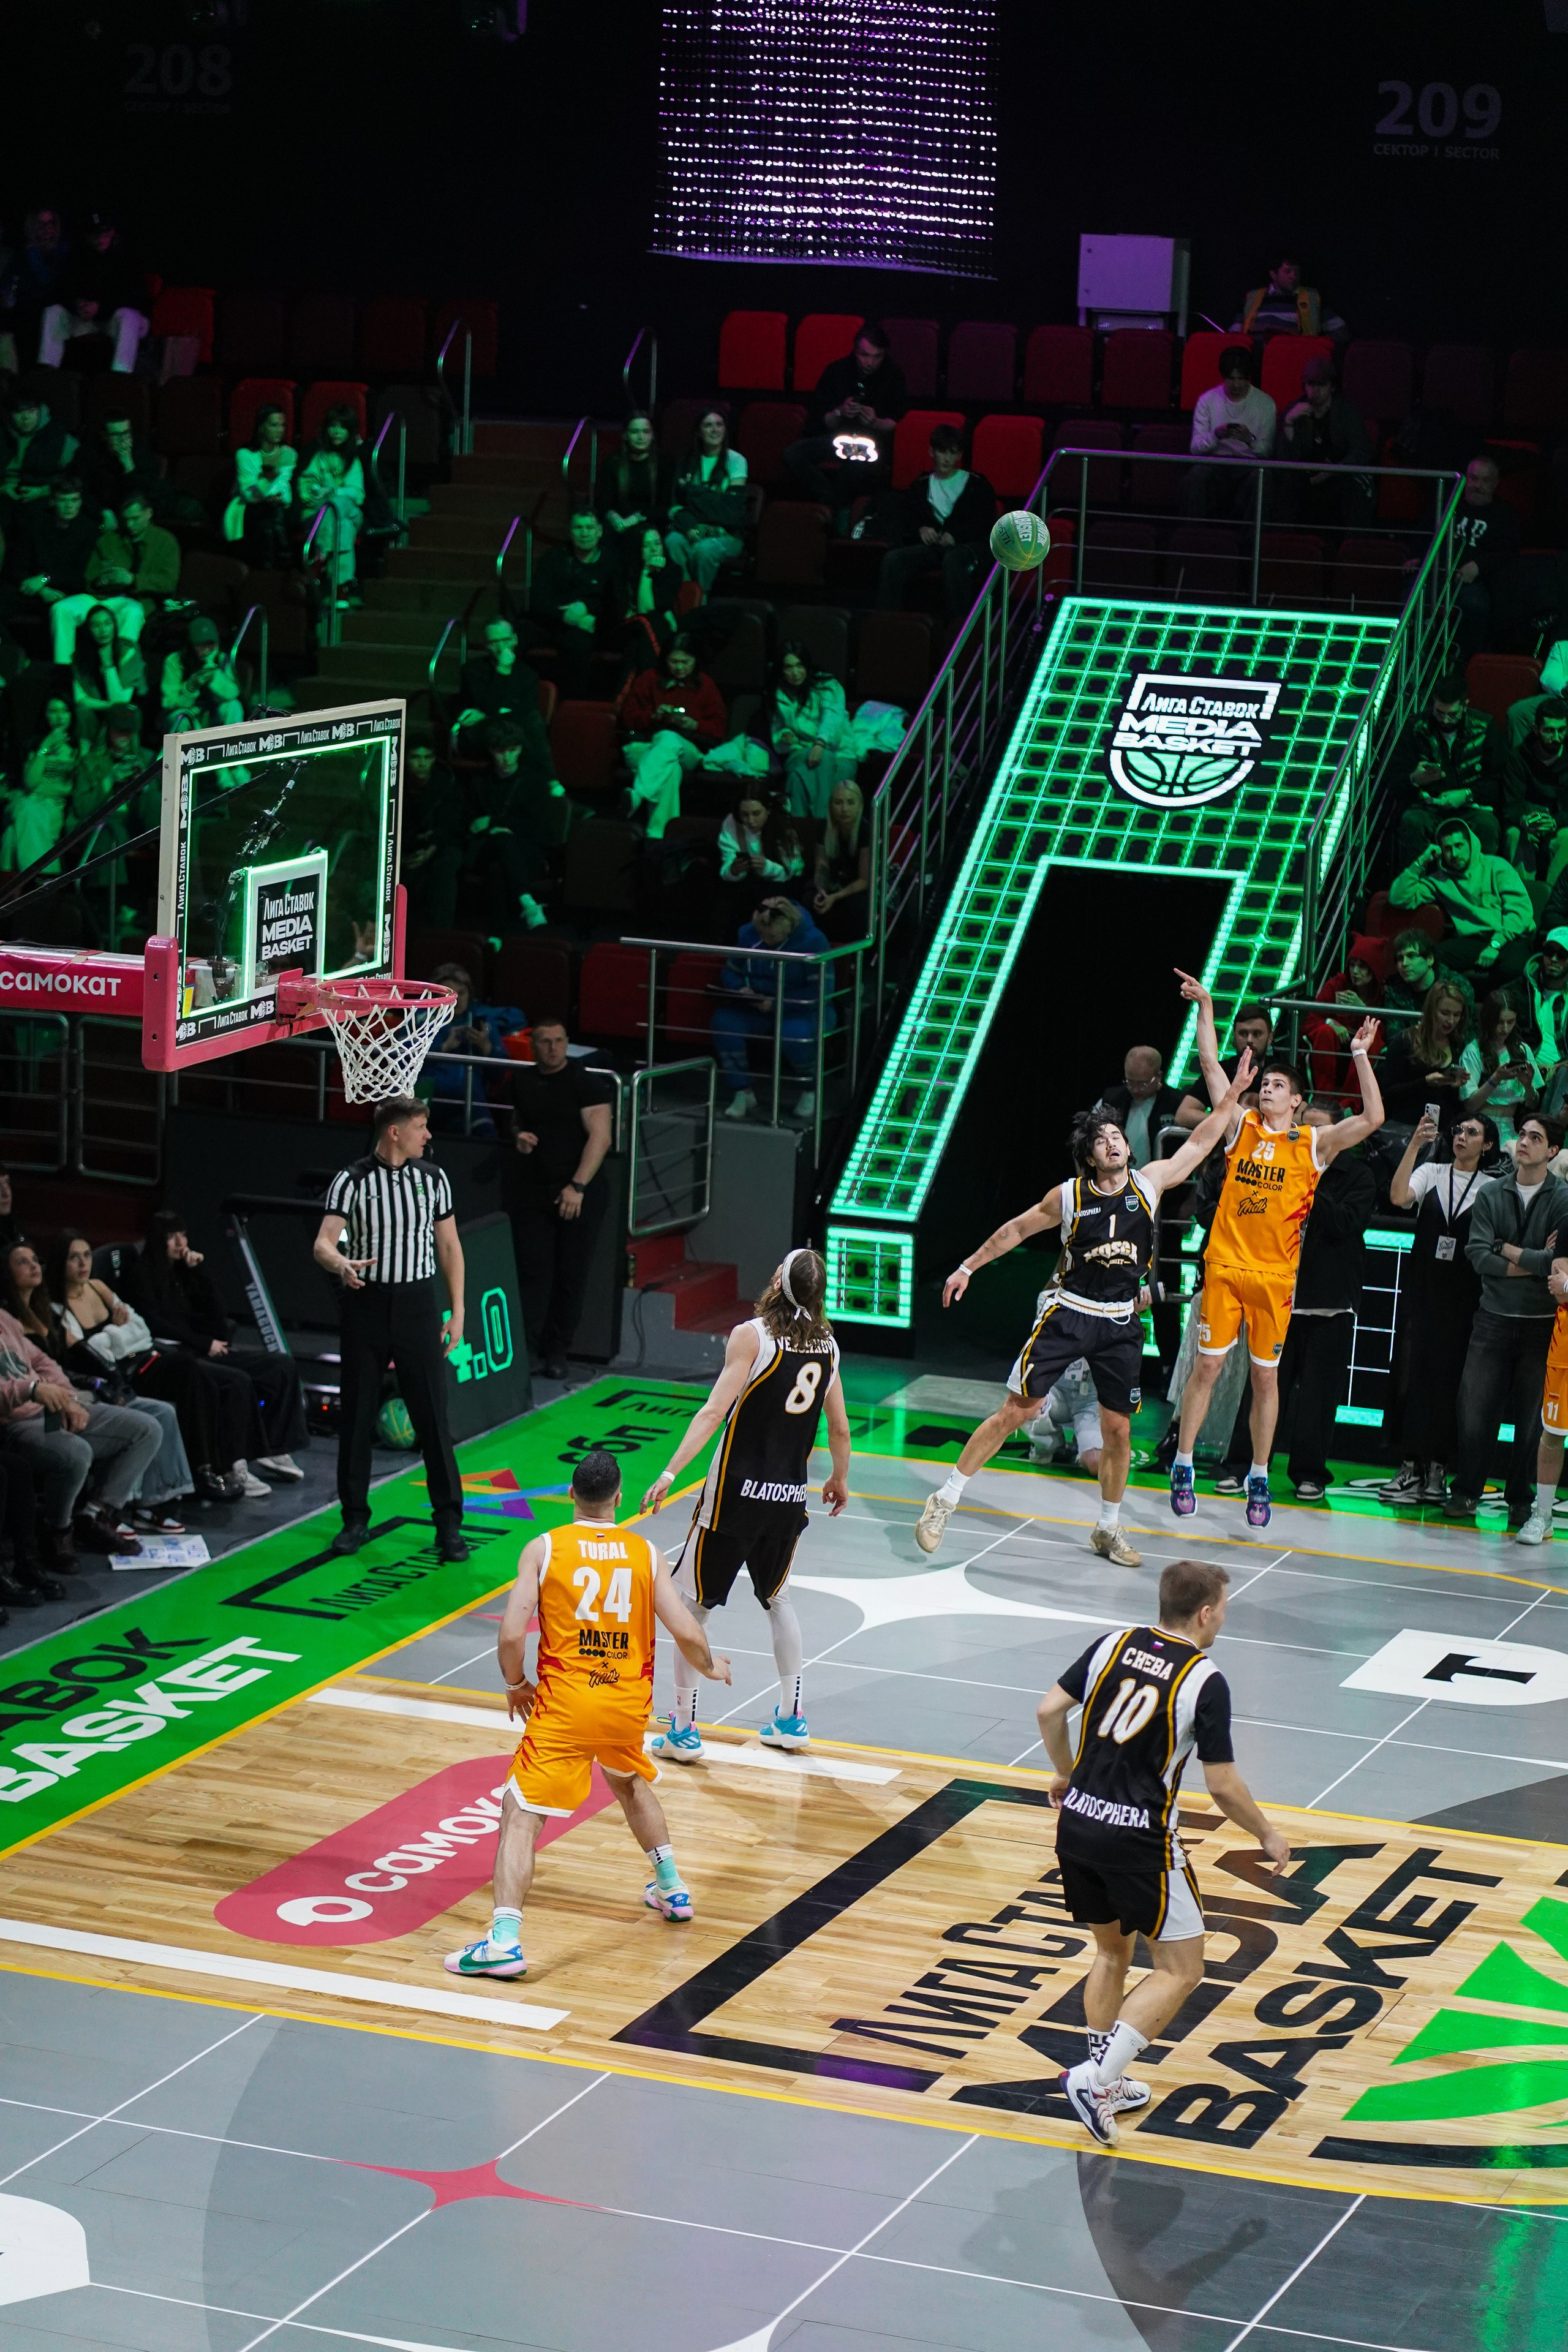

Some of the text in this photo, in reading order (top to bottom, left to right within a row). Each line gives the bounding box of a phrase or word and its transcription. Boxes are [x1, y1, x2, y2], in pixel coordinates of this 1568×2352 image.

[124, 43, 233, 96] 208
[1375, 80, 1501, 138] 209
[1118, 712, 1262, 741] MEDIA
[1112, 732, 1262, 756] BASKET
[262, 914, 313, 943] MEDIA
[262, 934, 313, 960] BASKET
[1251, 1140, 1276, 1161] 25
[1237, 1158, 1286, 1183] MASTER
[1257, 1181, 1283, 1192] COLOR
[1109, 1214, 1117, 1238] 1
[785, 1362, 822, 1414] 8
[1547, 1401, 1559, 1421] 11
[740, 1479, 807, 1502] BLATOSPHE
[578, 1540, 628, 1561] TURAL
[573, 1566, 633, 1623] 24
[579, 1629, 629, 1649] MASTER
[606, 1651, 628, 1660] COLOR
[1121, 1647, 1174, 1681] CHEBA
[0, 1636, 303, 1803] BASKET
[1097, 1678, 1159, 1745] 10
[345, 1783, 504, 1893] самок
[1135, 1846, 1505, 2150] BASKET
